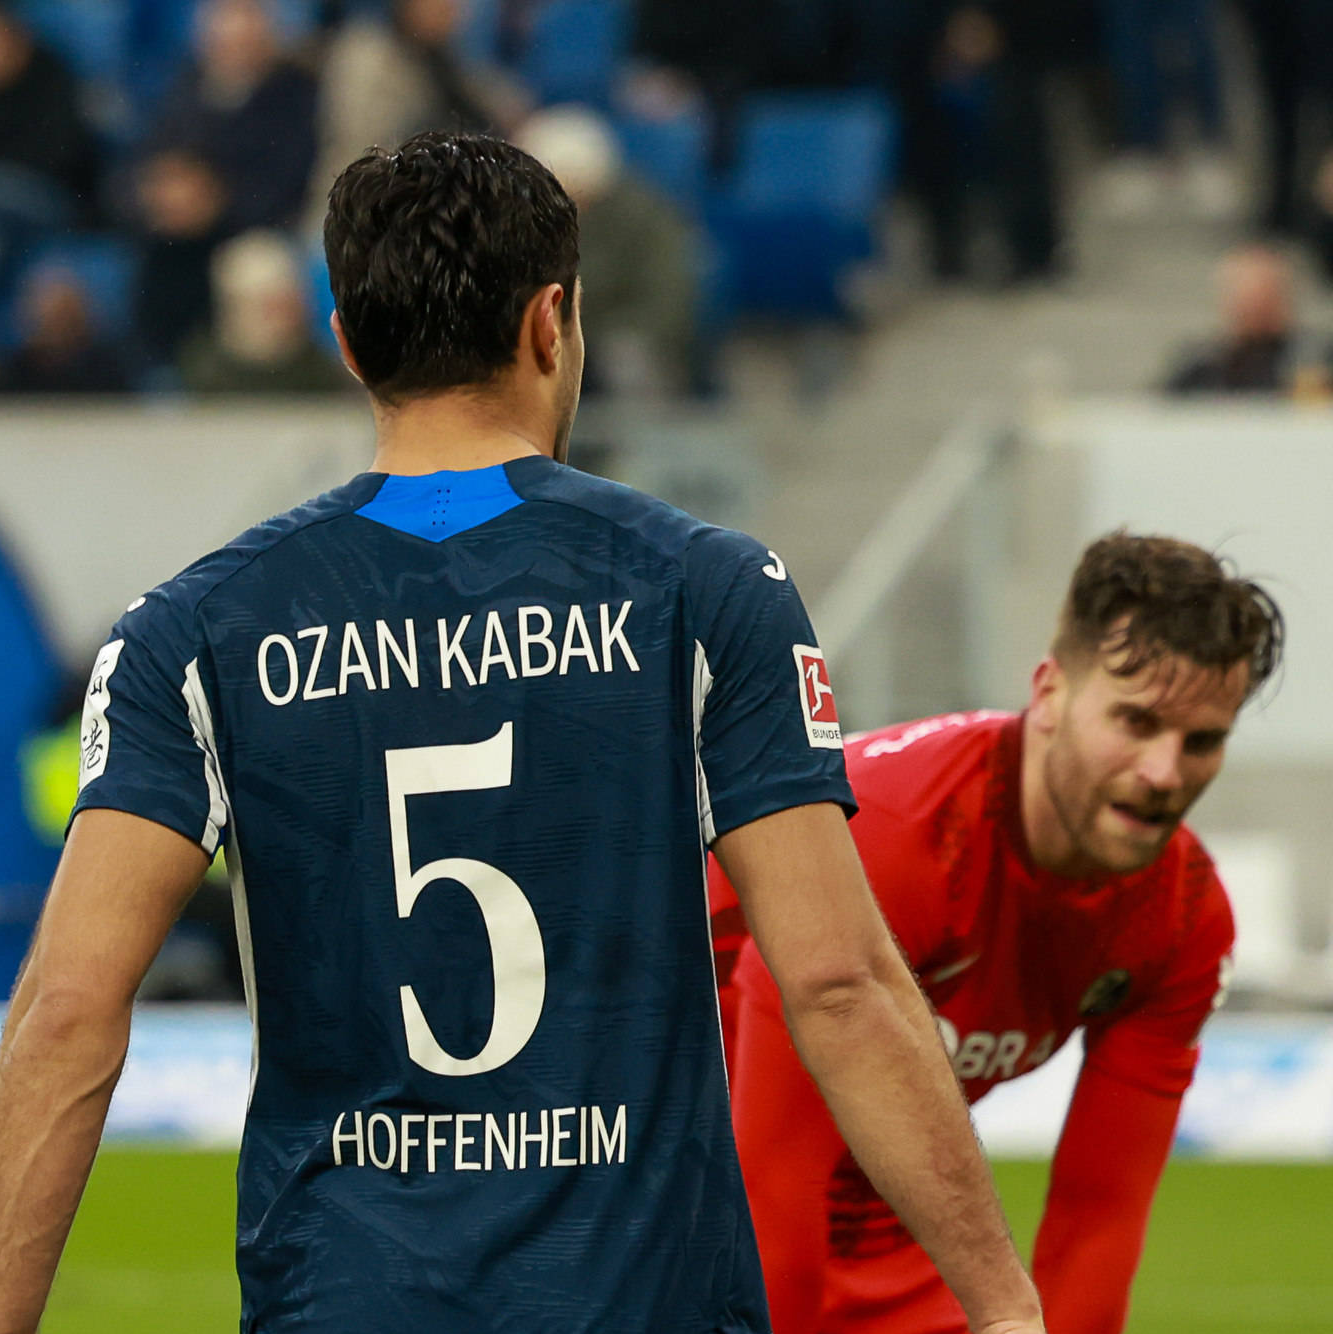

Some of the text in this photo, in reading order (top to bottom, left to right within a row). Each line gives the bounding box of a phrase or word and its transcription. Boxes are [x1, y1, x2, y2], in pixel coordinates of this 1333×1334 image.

[257, 600, 640, 706] OZAN KABAK
[385, 721, 546, 1077] 5
[333, 1104, 627, 1174] HOFFENHEIM
